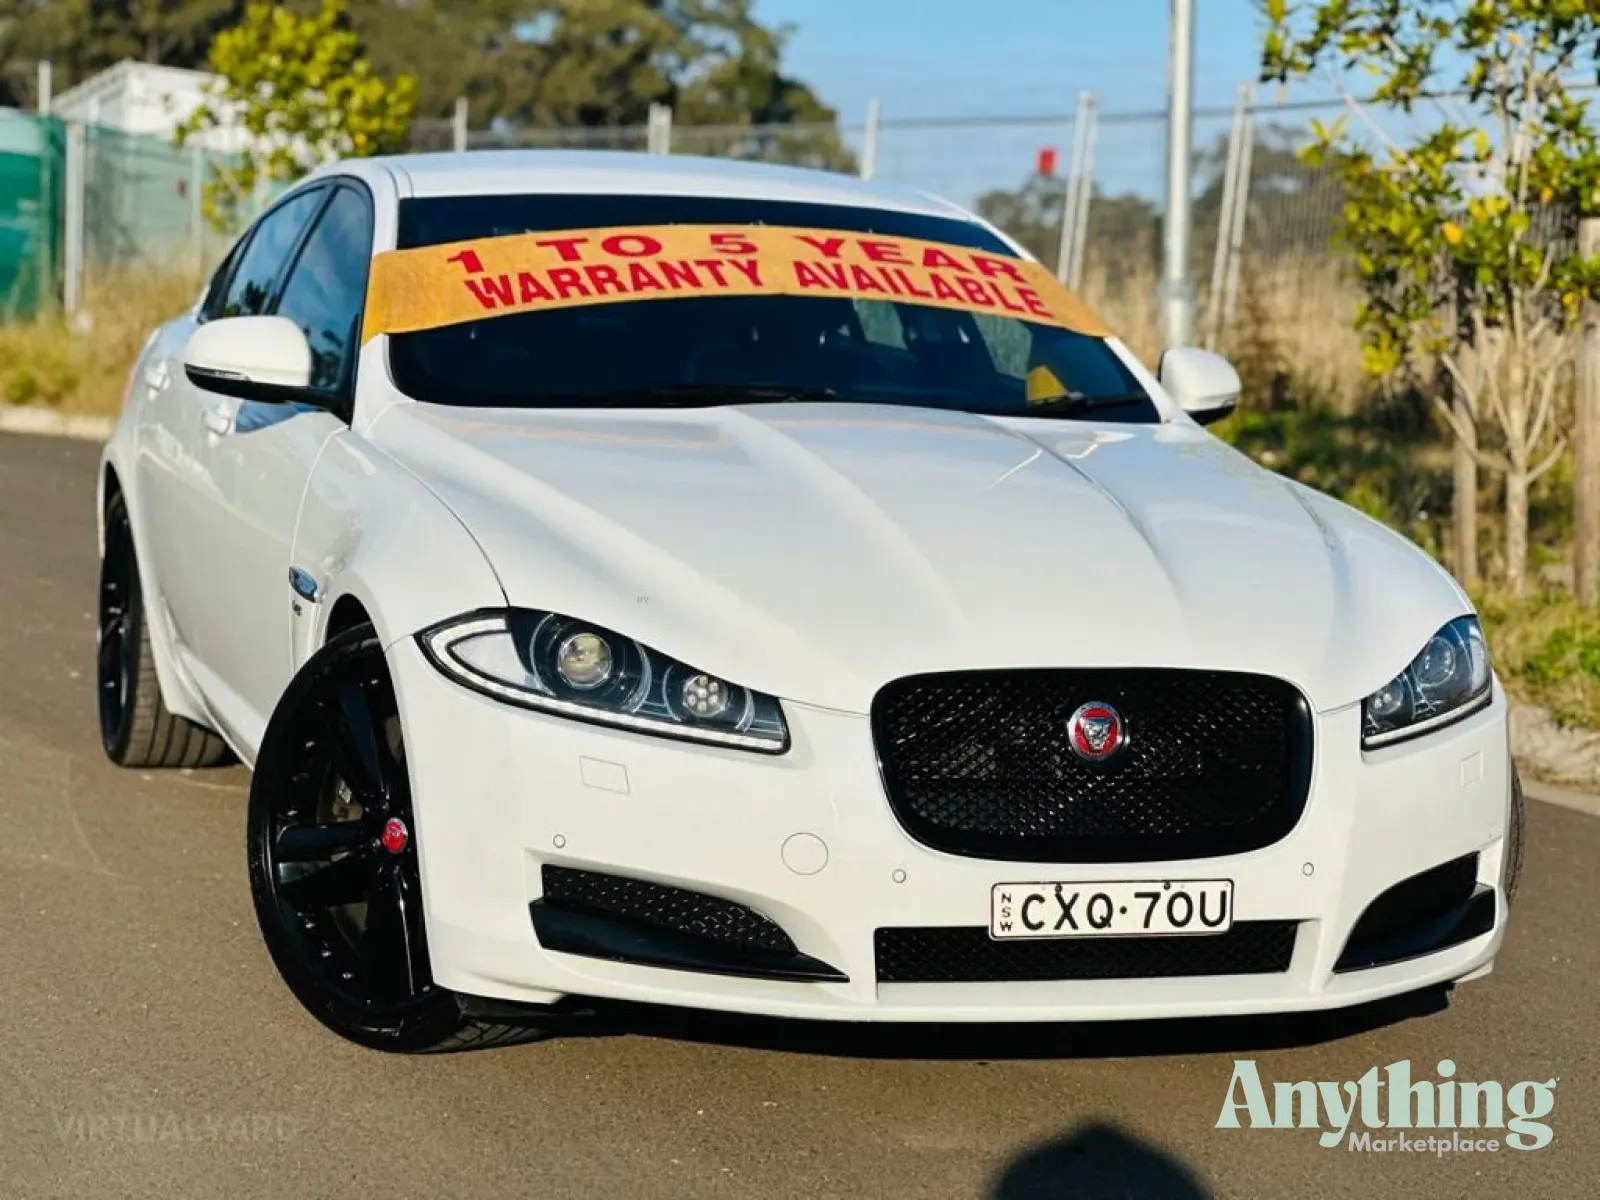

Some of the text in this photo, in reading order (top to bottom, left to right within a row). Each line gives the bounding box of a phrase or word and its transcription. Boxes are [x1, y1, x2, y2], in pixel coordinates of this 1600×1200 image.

[447, 233, 1027, 284] 1 TO 5 YEAR
[464, 258, 1054, 318] WARRANTY AVAILABLE
